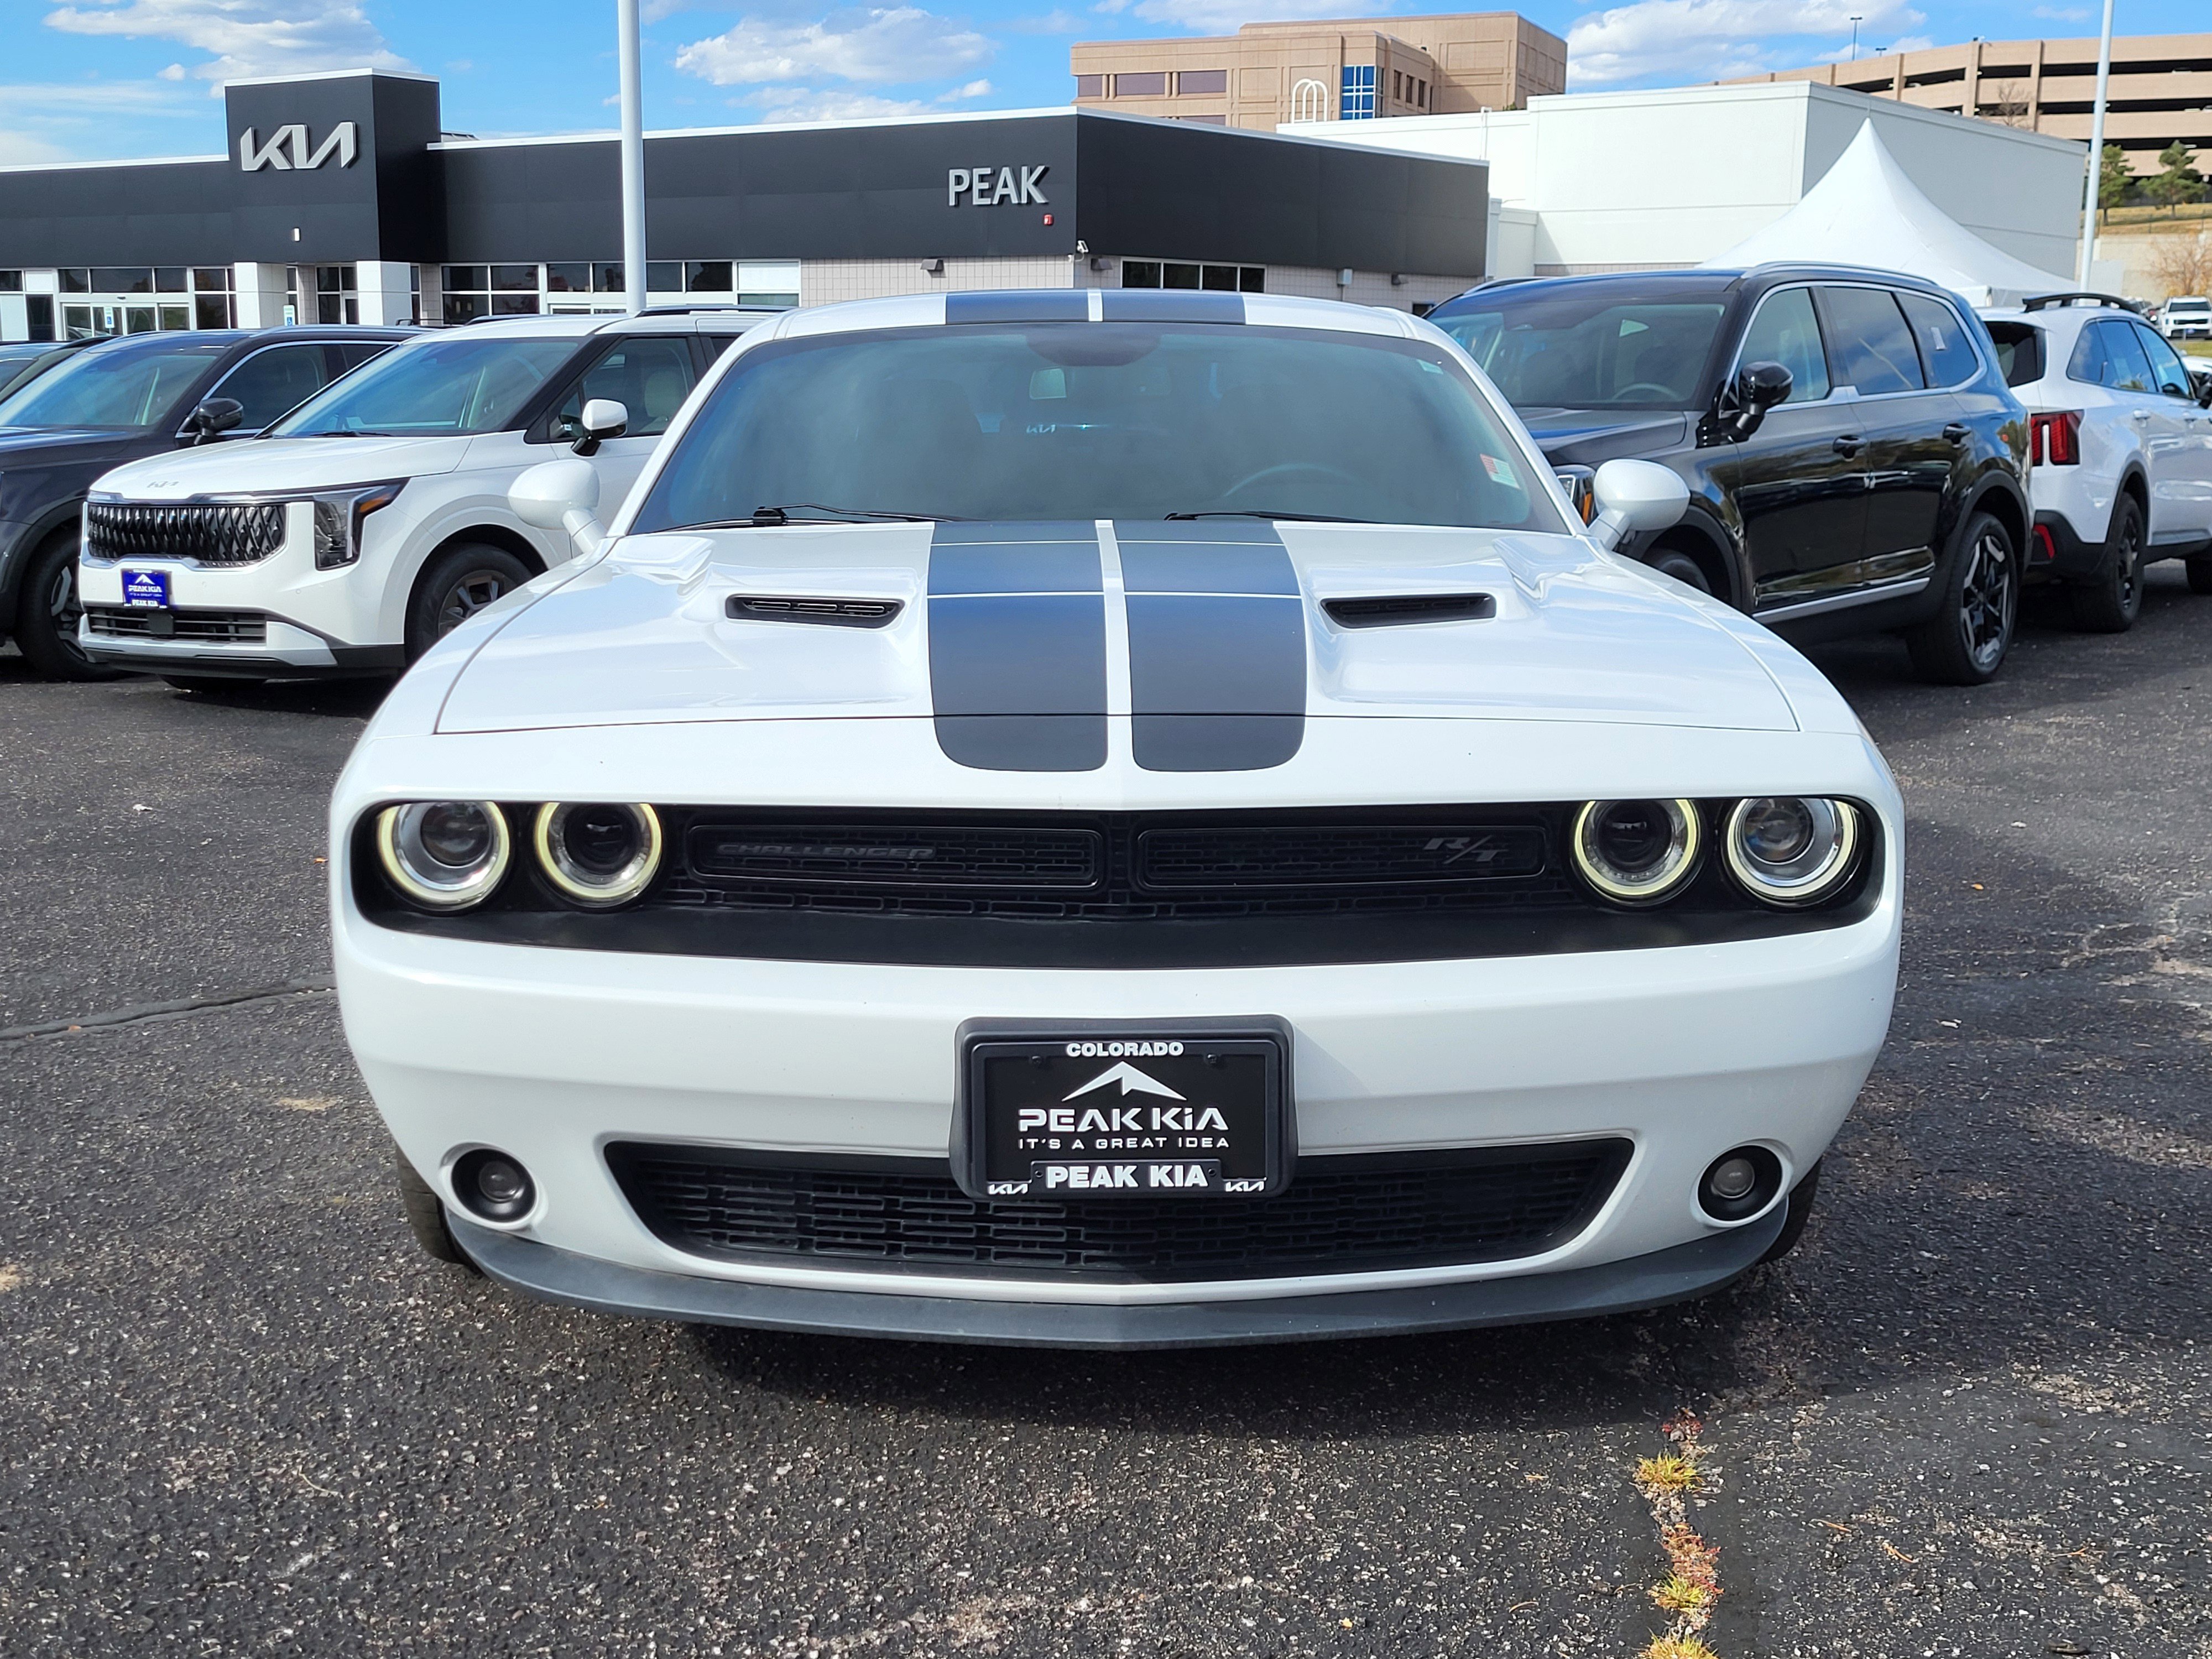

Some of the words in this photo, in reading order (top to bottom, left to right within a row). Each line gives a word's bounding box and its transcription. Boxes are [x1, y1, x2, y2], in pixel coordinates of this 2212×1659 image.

[240, 122, 355, 171] KIA
[949, 165, 1049, 206] PEAK
[719, 844, 934, 858] CHALLENGER
[1423, 834, 1509, 864] R/T
[1066, 1041, 1184, 1057] COLORADO
[1019, 1108, 1144, 1132] PEAK
[1019, 1138, 1061, 1150] IT'S
[1071, 1139, 1085, 1150] A
[1095, 1137, 1167, 1150] GREAT
[1178, 1137, 1229, 1148] IDEA
[1046, 1165, 1139, 1188] PEAK
[1150, 1164, 1208, 1187] KIA
[1224, 1180, 1265, 1192] KIA
[987, 1183, 1029, 1195] KIA
